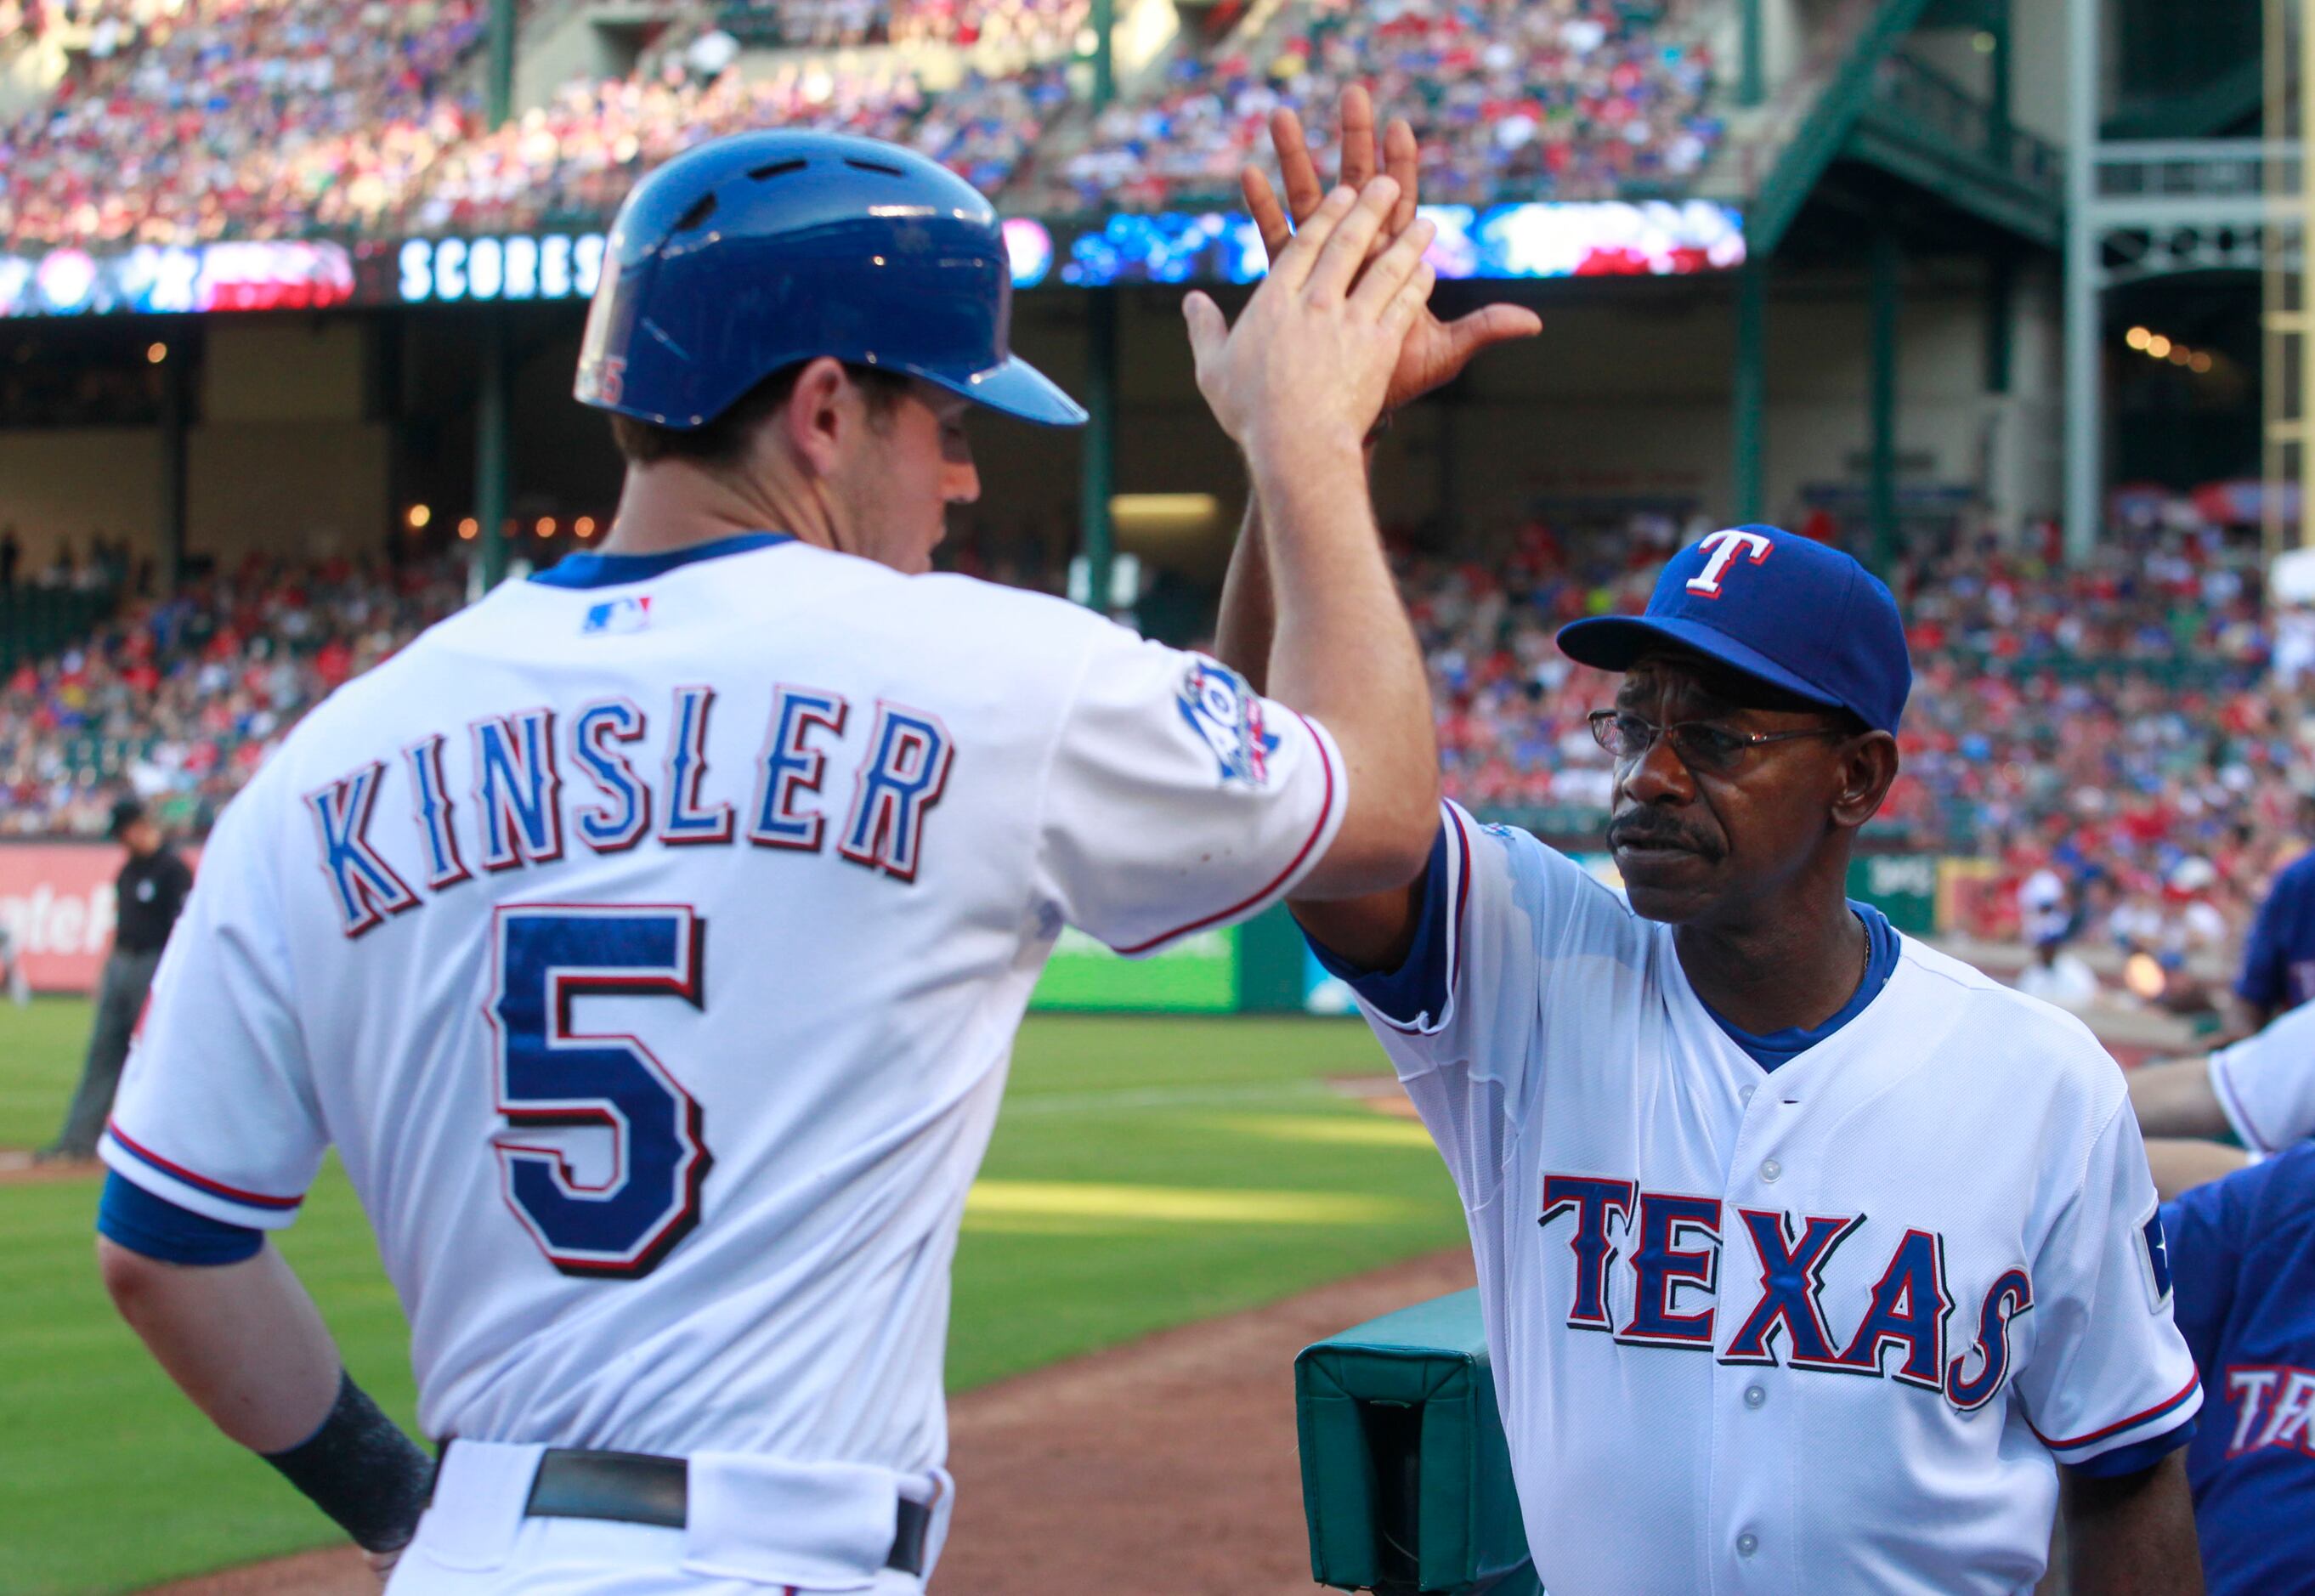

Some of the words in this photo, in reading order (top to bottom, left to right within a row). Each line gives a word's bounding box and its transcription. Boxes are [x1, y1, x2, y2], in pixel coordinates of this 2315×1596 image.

[399, 235, 606, 303] SCORES
[601, 355, 628, 406] 5
[1686, 529, 1774, 600] T
[304, 684, 955, 938] KINSLER
[484, 903, 713, 1280] 5
[1538, 1170, 2035, 1414] TEXAS
